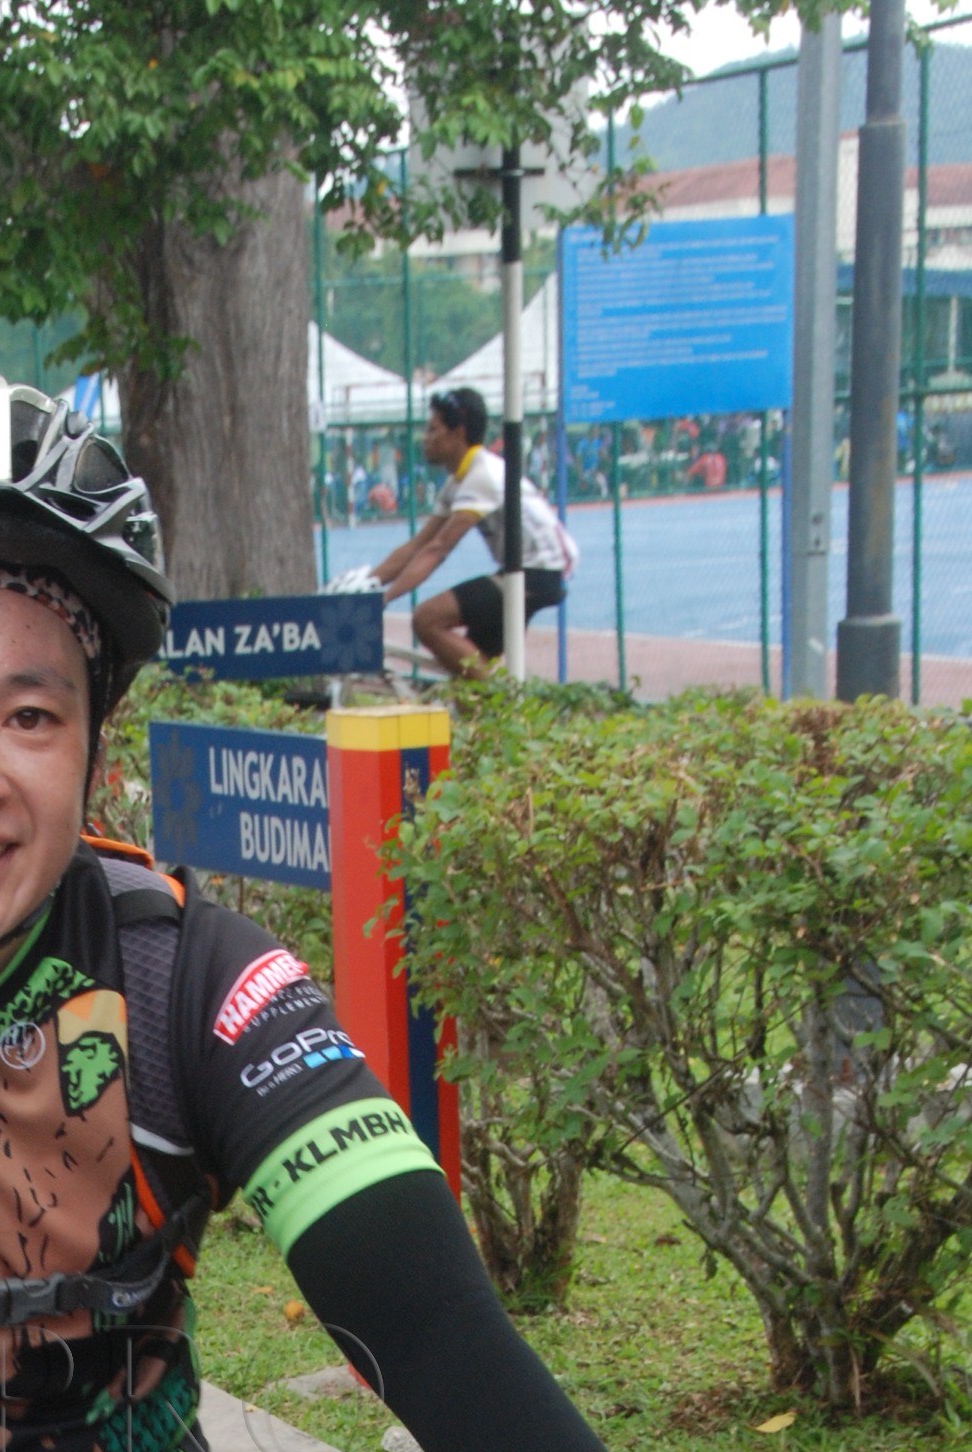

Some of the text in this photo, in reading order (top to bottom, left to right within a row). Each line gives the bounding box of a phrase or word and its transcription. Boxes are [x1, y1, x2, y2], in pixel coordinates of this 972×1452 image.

[233, 621, 322, 656] ZA'BA
[208, 746, 330, 809] LINGKARA
[239, 811, 332, 873] BUDIMA
[282, 1110, 411, 1183] KLMBH
